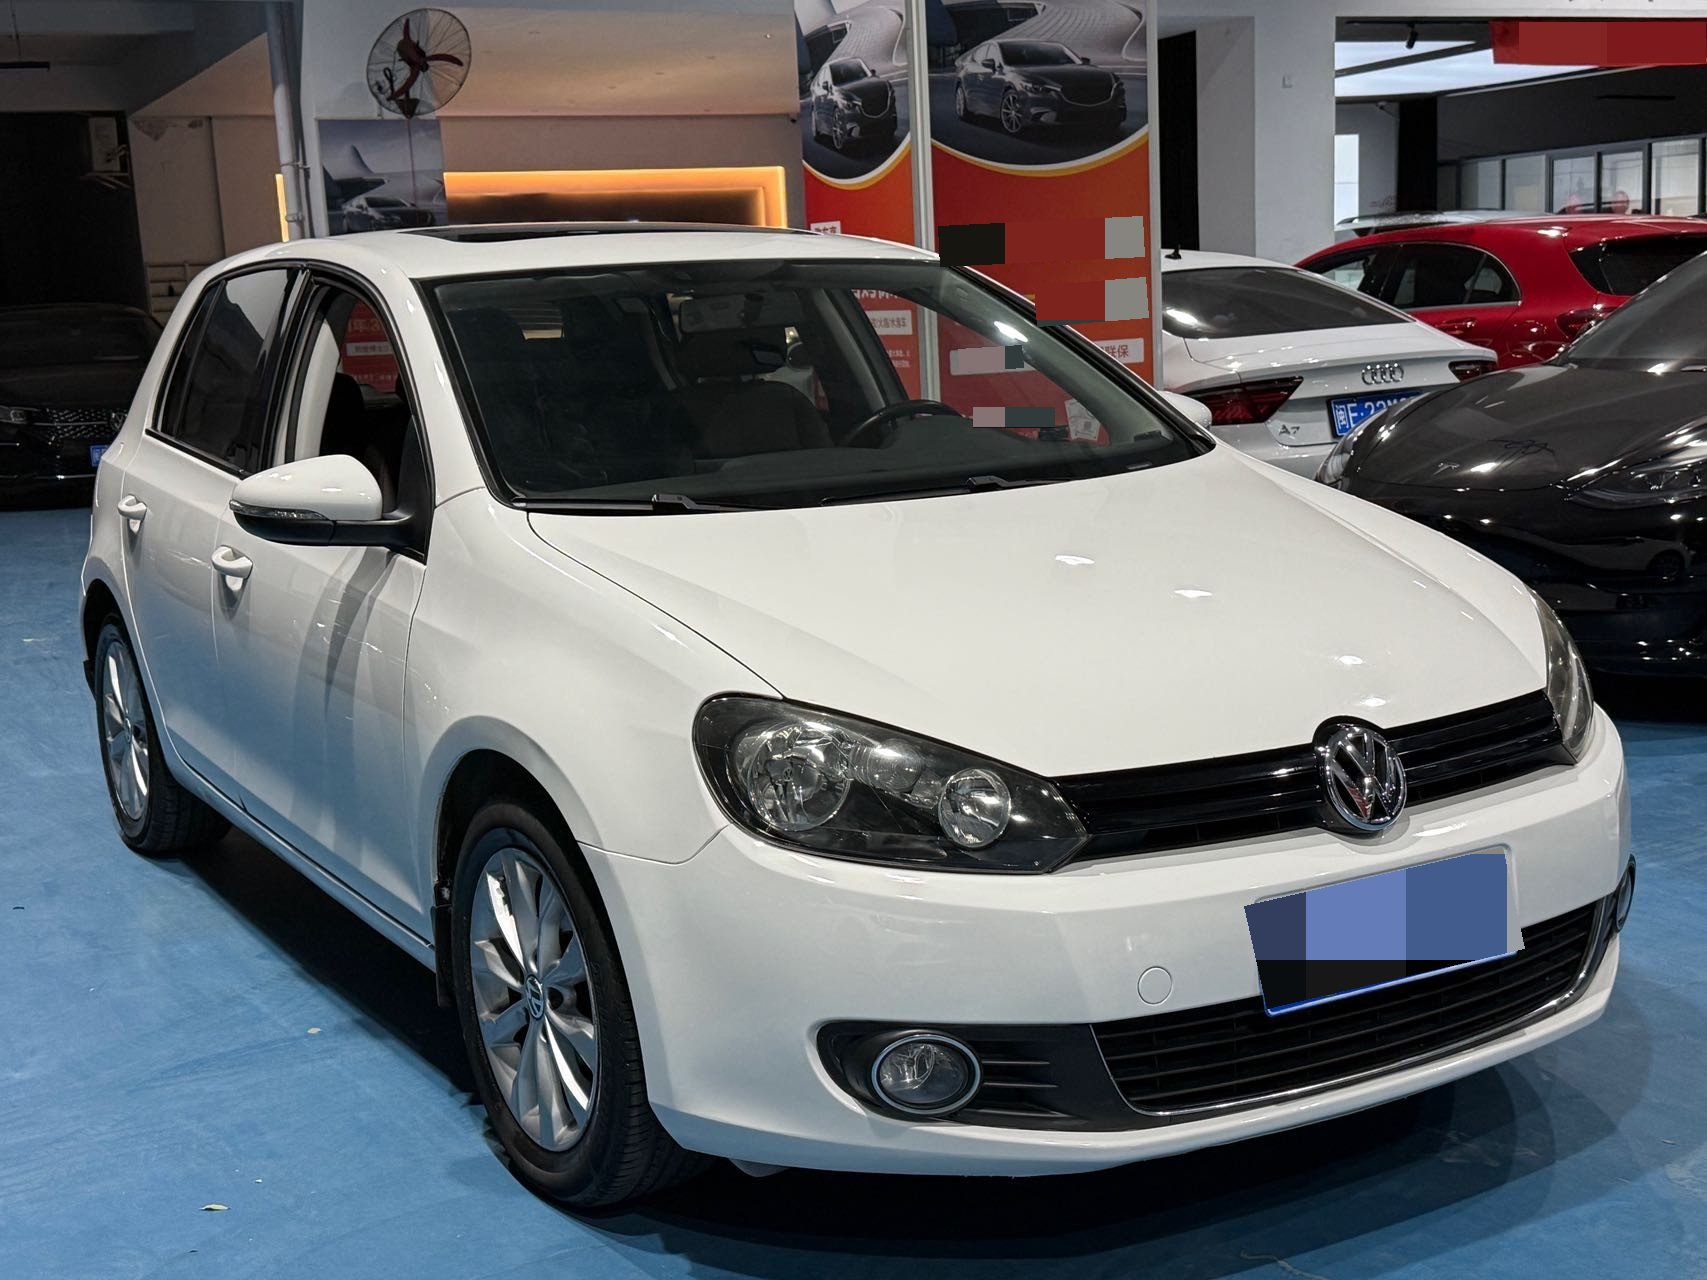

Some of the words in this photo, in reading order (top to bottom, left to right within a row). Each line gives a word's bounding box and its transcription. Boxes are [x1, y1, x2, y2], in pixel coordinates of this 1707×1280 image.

[1101, 344, 1129, 358] 联保
[1335, 398, 1407, 430] 闽E·2
[1279, 424, 1300, 436] A7
